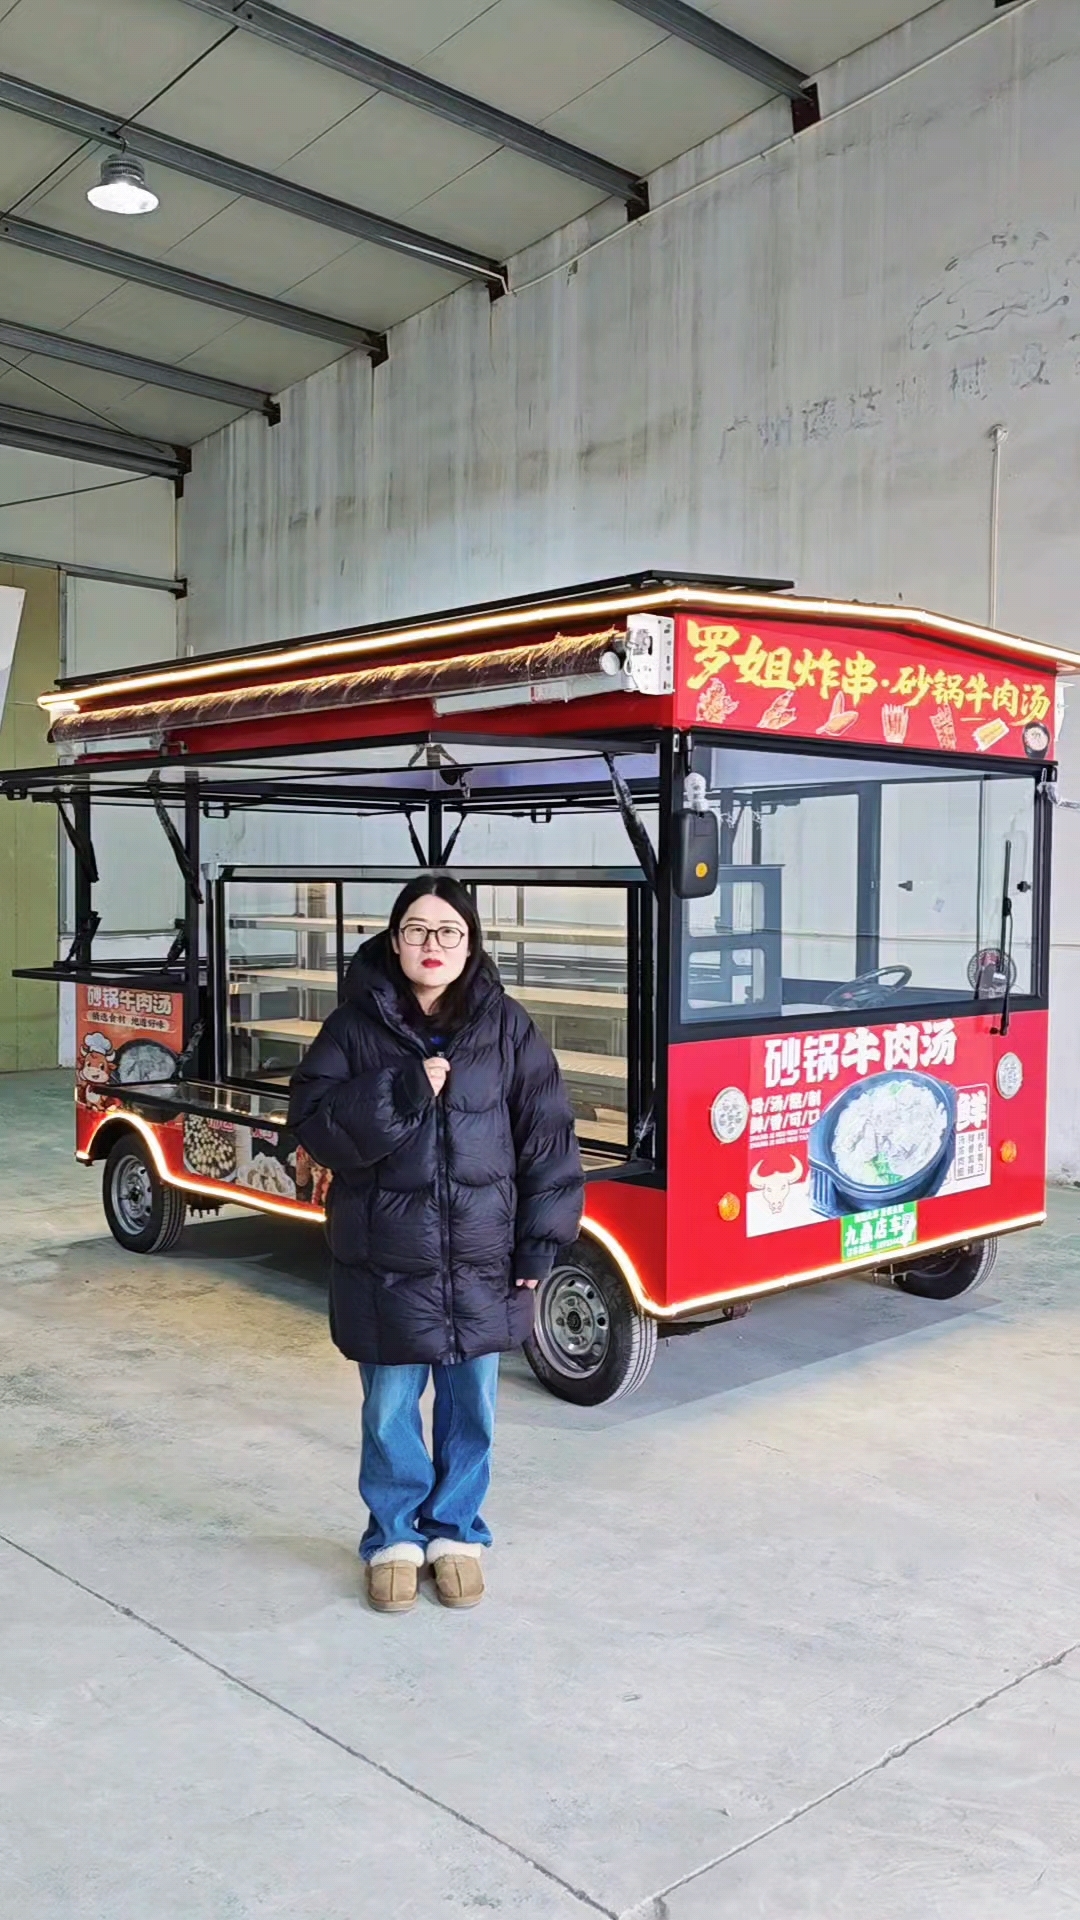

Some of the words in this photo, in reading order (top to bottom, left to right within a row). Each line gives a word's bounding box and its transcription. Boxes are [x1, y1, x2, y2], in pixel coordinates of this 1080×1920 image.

[87, 985, 172, 1015] 砂锅牛肉汤
[764, 1018, 958, 1088] 砂锅牛肉汤
[956, 1090, 987, 1131] 鲜
